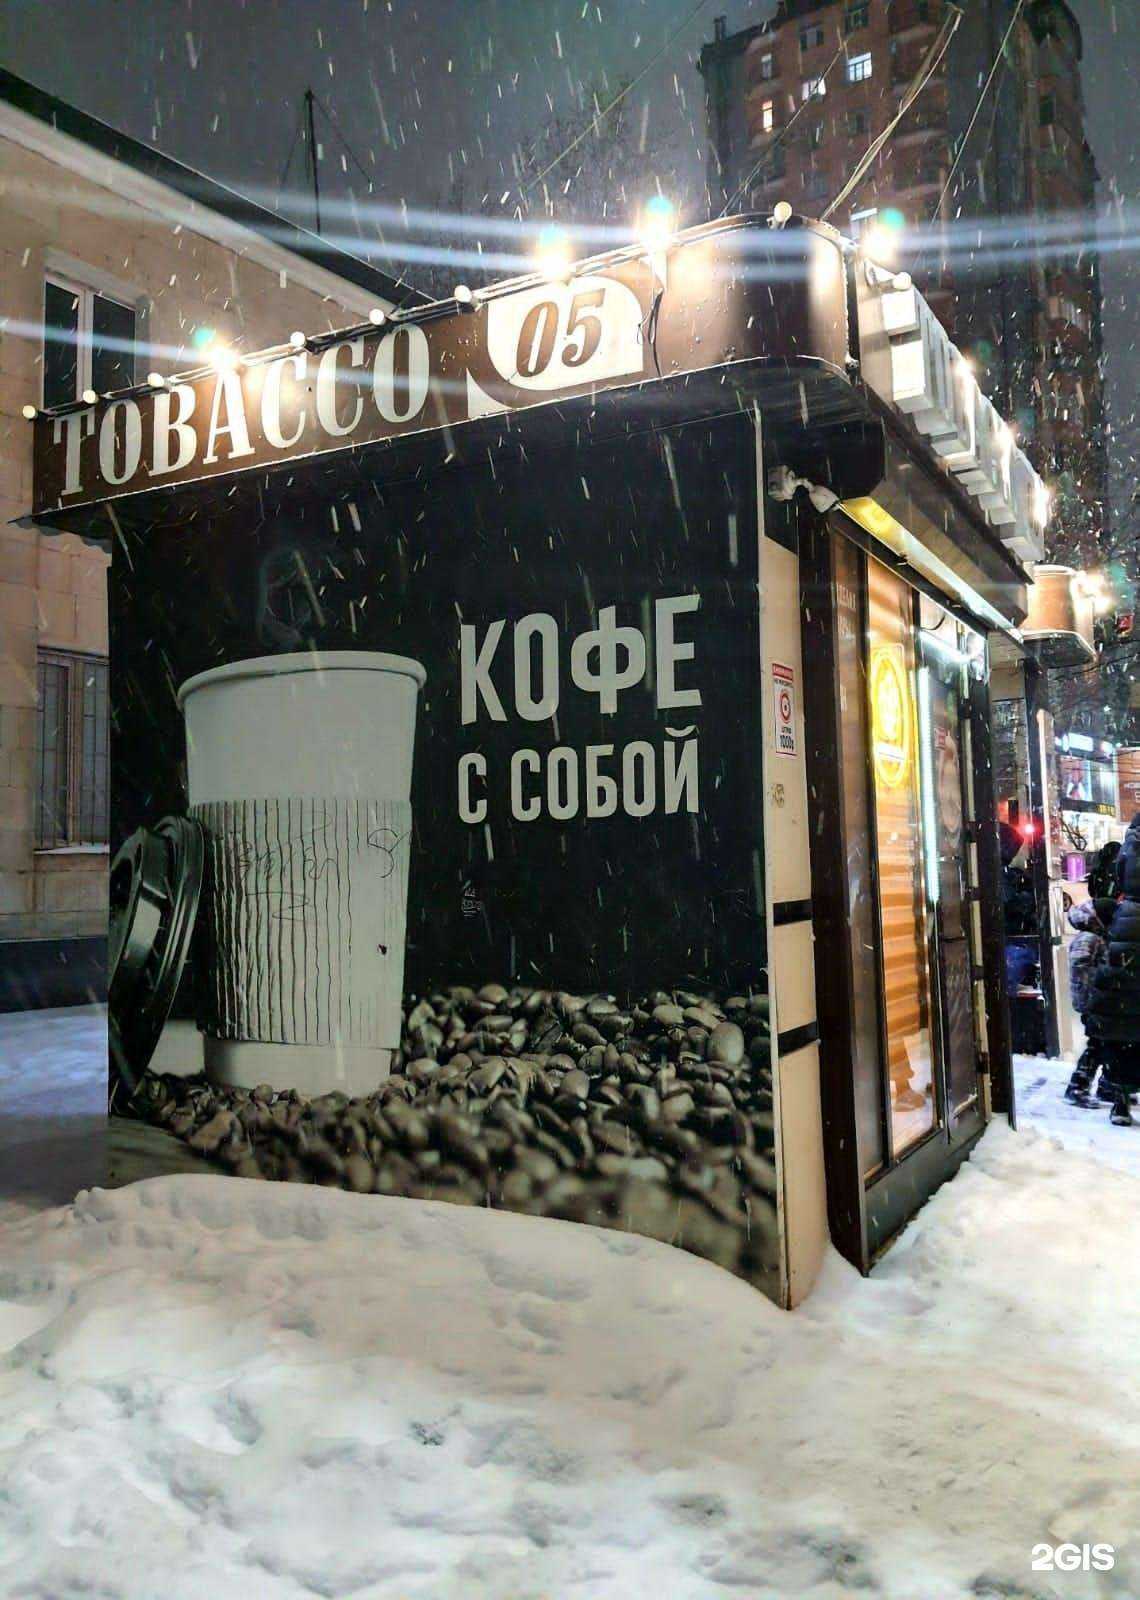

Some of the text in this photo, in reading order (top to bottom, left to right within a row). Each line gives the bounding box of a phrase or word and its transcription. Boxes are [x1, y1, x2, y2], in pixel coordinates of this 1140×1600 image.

[515, 287, 606, 378] 05
[53, 323, 430, 496] TOBACCO
[460, 594, 703, 726] КОФЕ
[457, 724, 700, 825] С СОБОЙ
